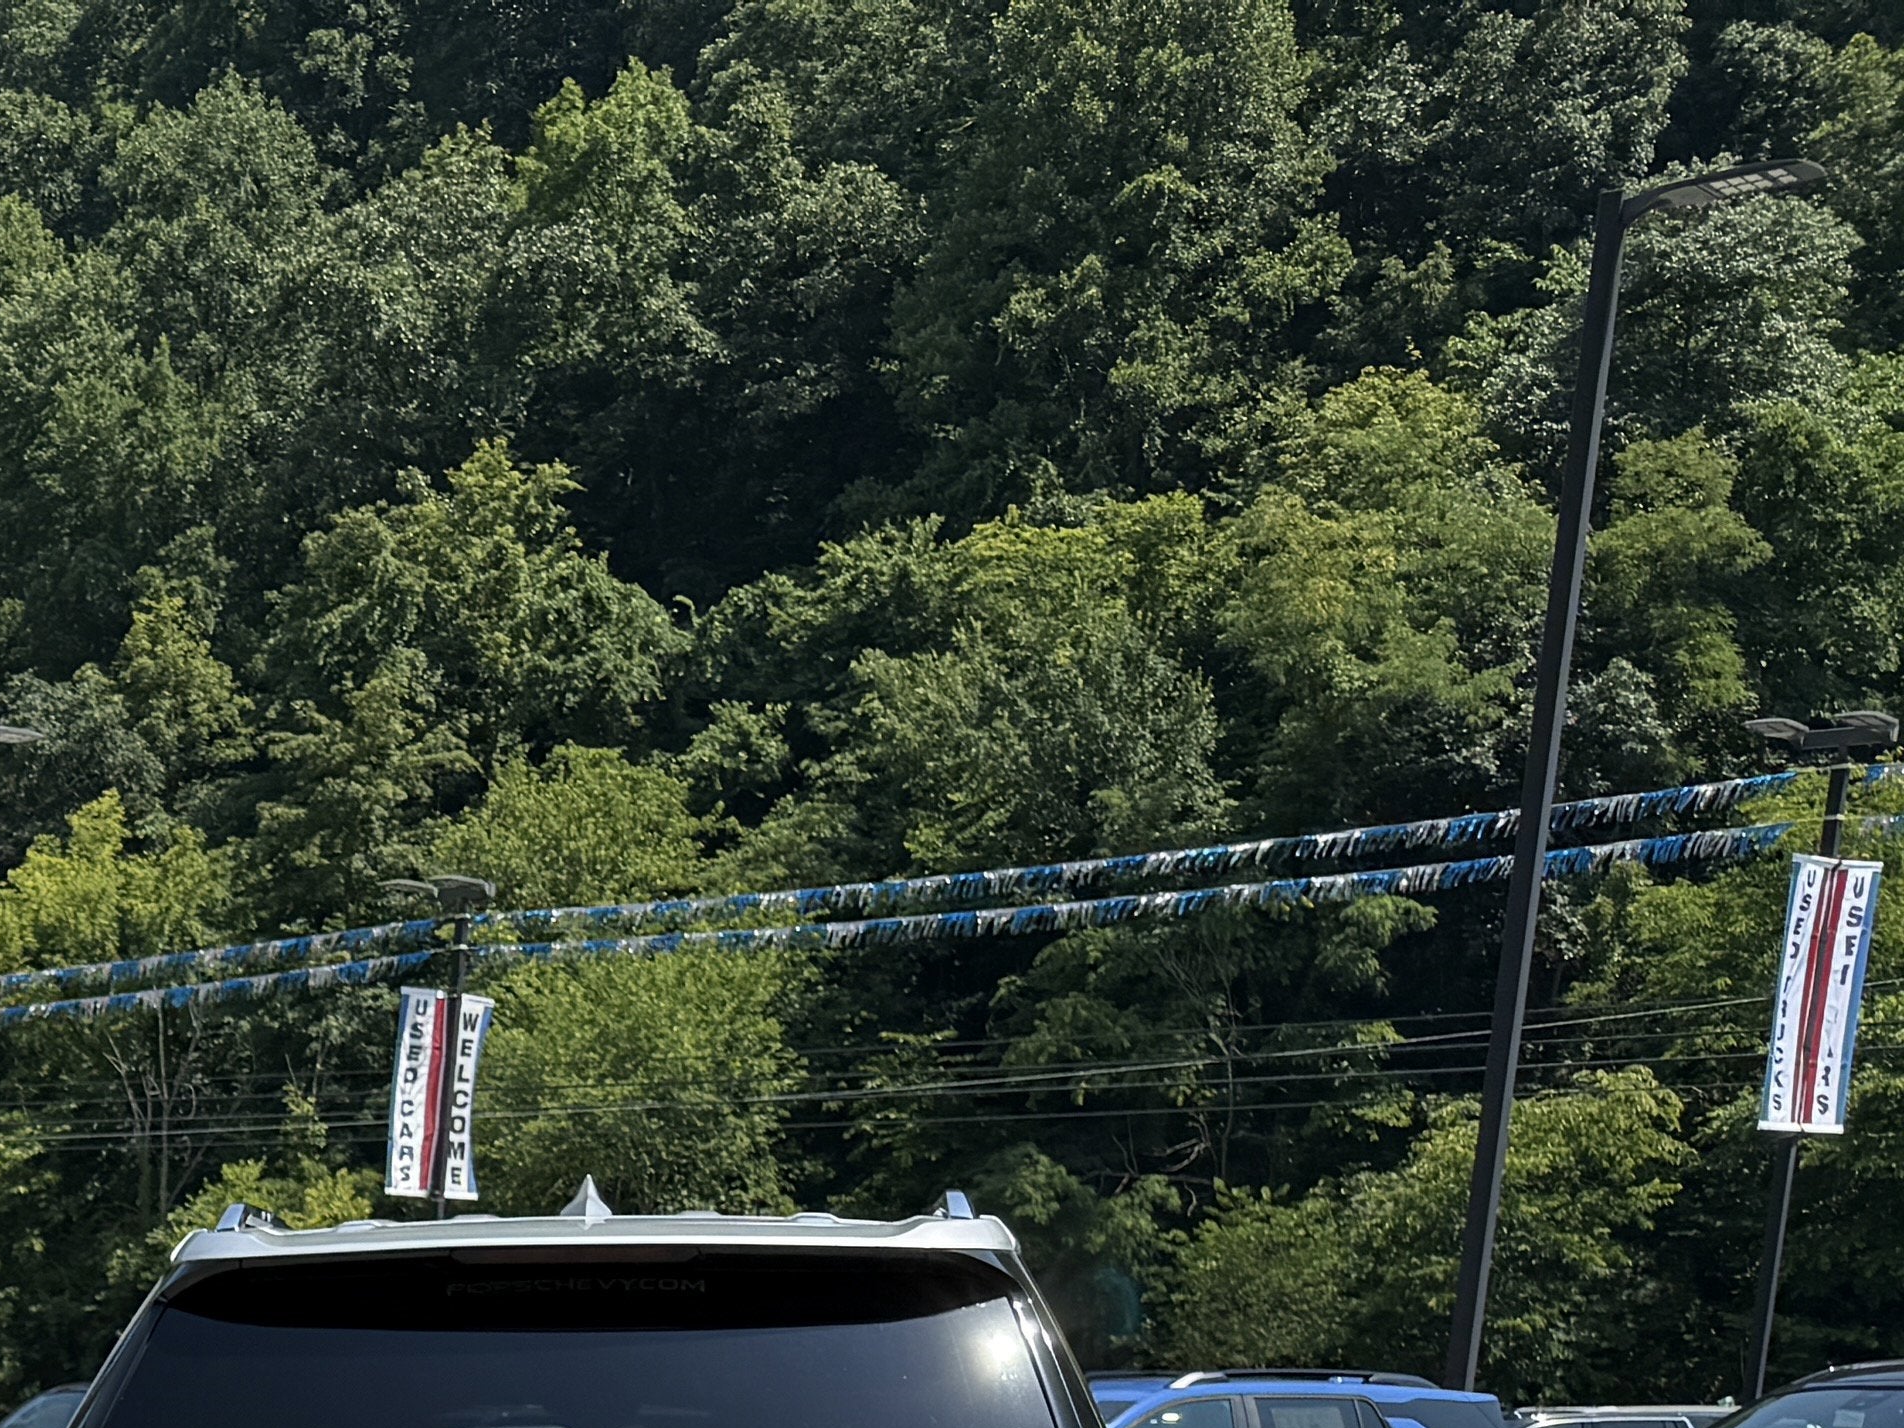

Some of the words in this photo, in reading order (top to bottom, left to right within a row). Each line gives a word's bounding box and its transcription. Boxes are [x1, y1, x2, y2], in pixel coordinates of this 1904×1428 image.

[403, 998, 428, 1084] USED
[398, 1099, 415, 1182] CARS
[447, 1012, 480, 1185] WELCOME
